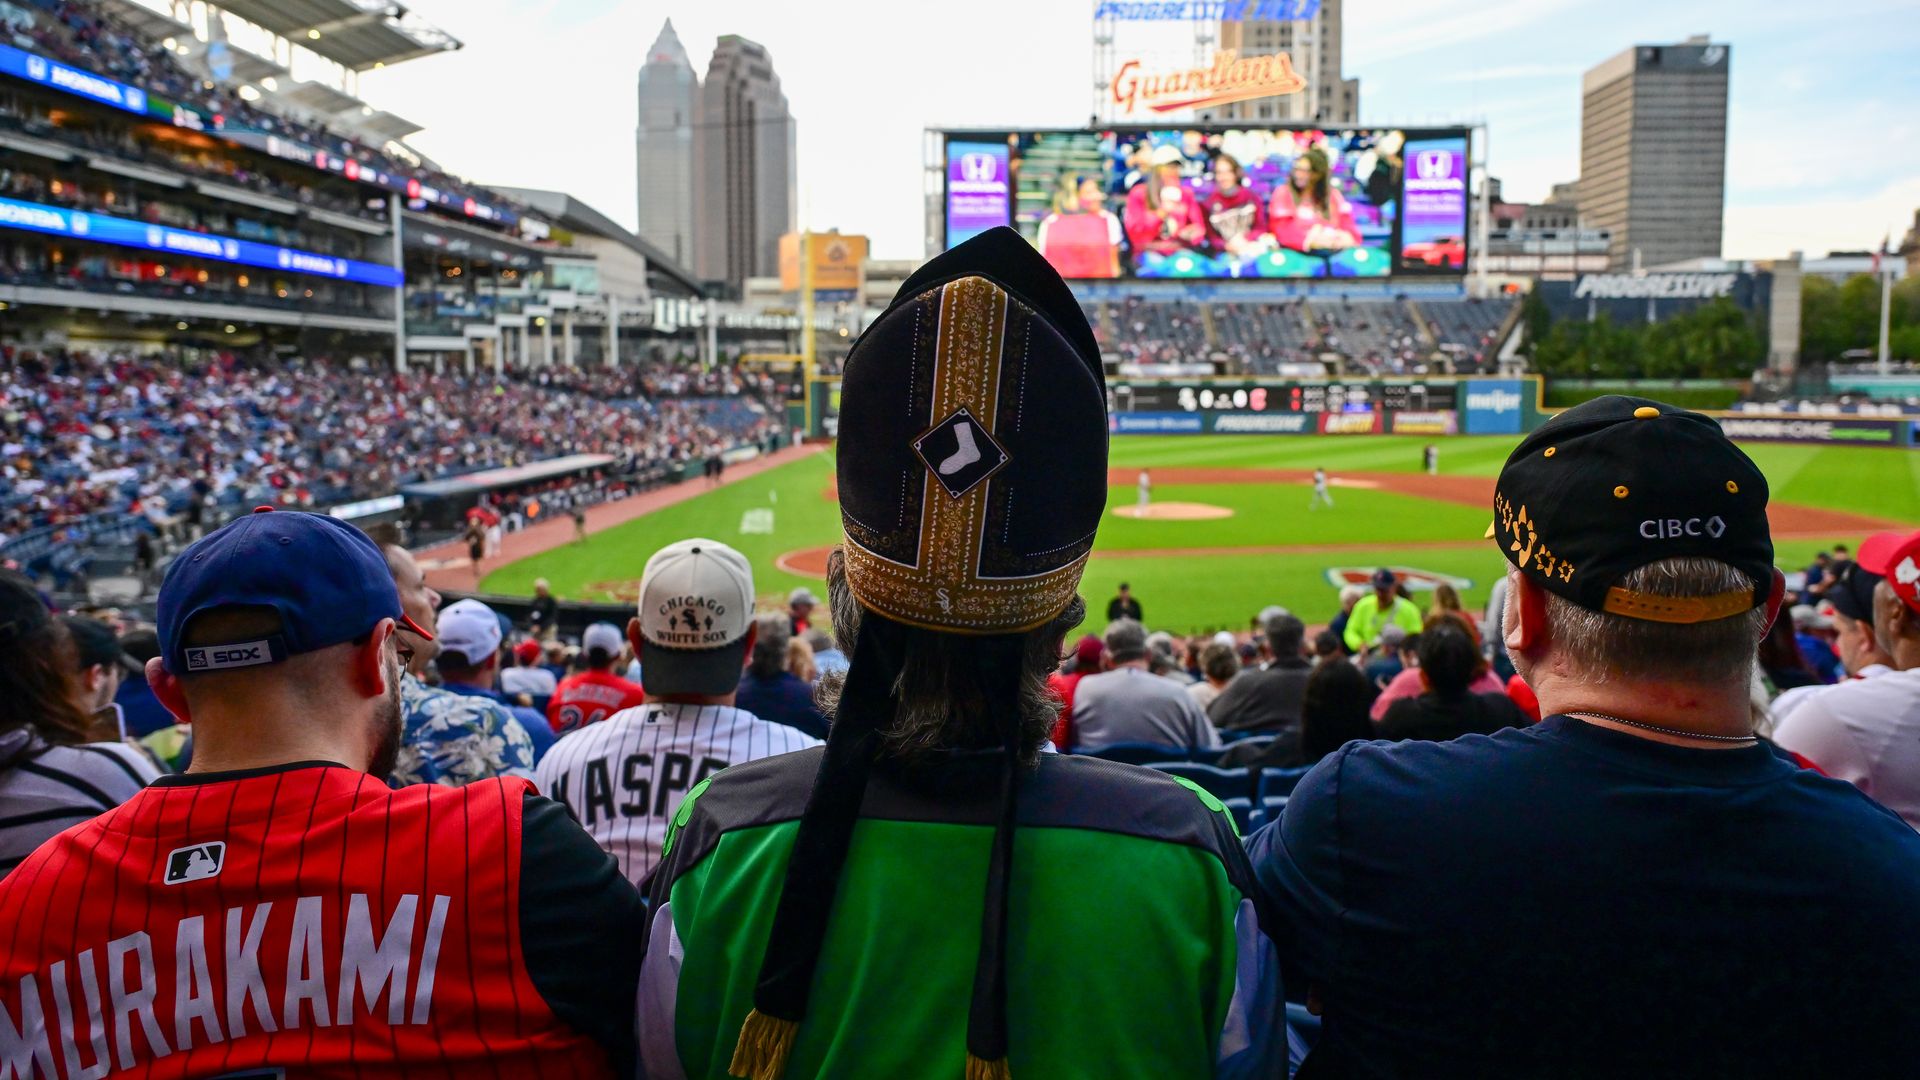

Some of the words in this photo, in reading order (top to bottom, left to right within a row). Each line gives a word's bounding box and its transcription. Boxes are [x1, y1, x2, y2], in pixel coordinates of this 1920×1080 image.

[1110, 48, 1306, 113] Guardians
[1574, 273, 1738, 299] PROGRESSIVE
[1639, 517, 1702, 539] CIBC
[659, 595, 726, 616] CHICAGO
[656, 629, 700, 643] WHITE
[703, 629, 728, 643] SOX
[213, 646, 262, 664] SOX
[0, 892, 452, 1080] MURAKAMI
